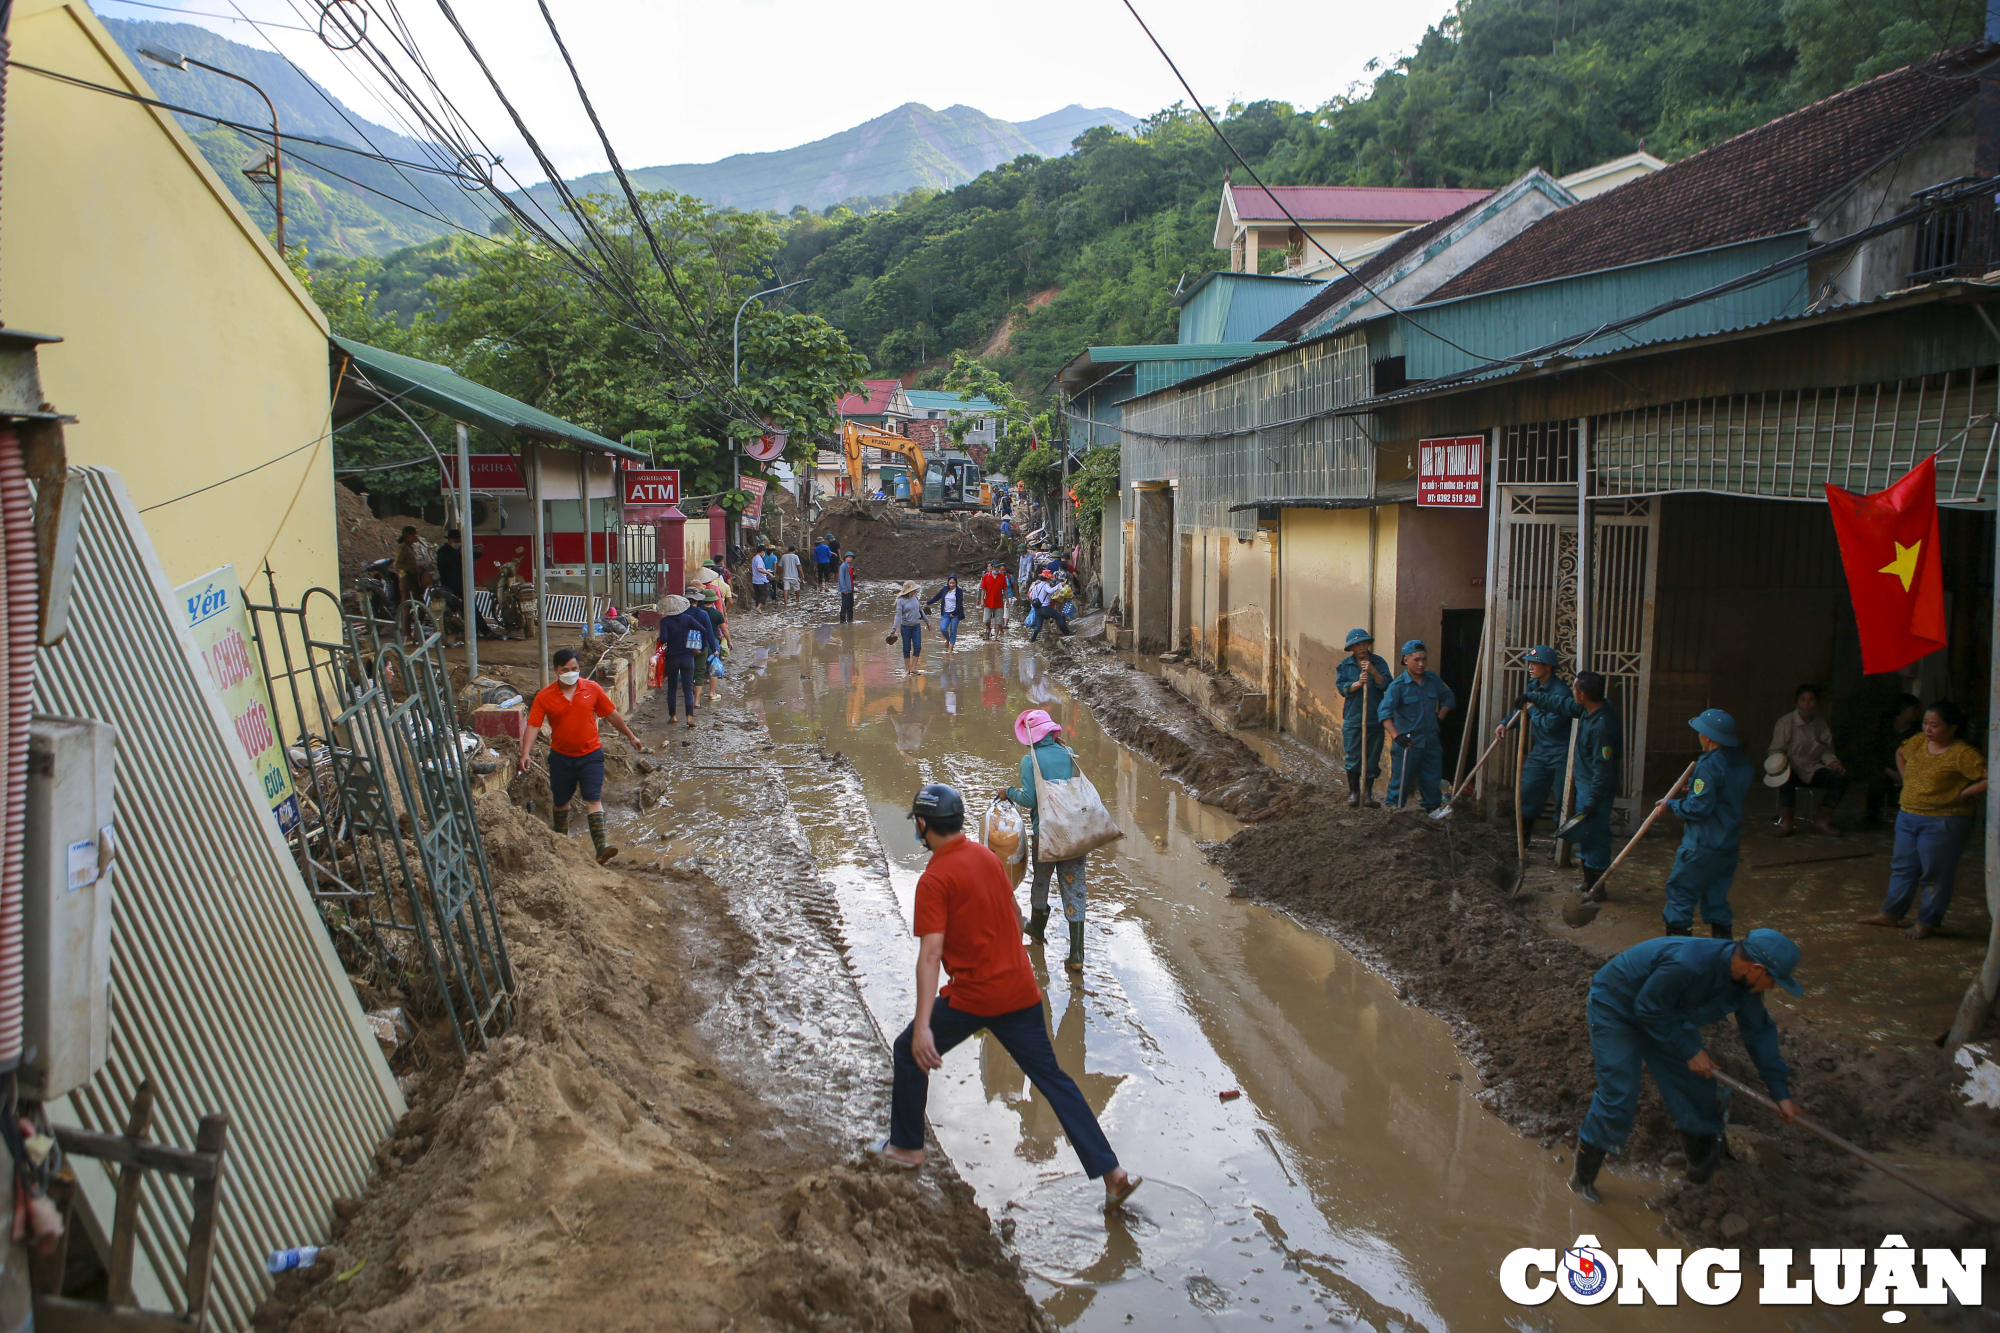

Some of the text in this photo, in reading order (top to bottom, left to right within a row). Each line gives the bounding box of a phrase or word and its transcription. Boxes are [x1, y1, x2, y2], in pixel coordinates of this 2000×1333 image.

[1467, 444, 1480, 475] LAN
[630, 484, 674, 500] ATM
[1437, 494, 1451, 503] 0392
[1452, 494, 1463, 503] 519
[212, 625, 254, 691] CHỮA
[264, 763, 286, 799] CỬA
